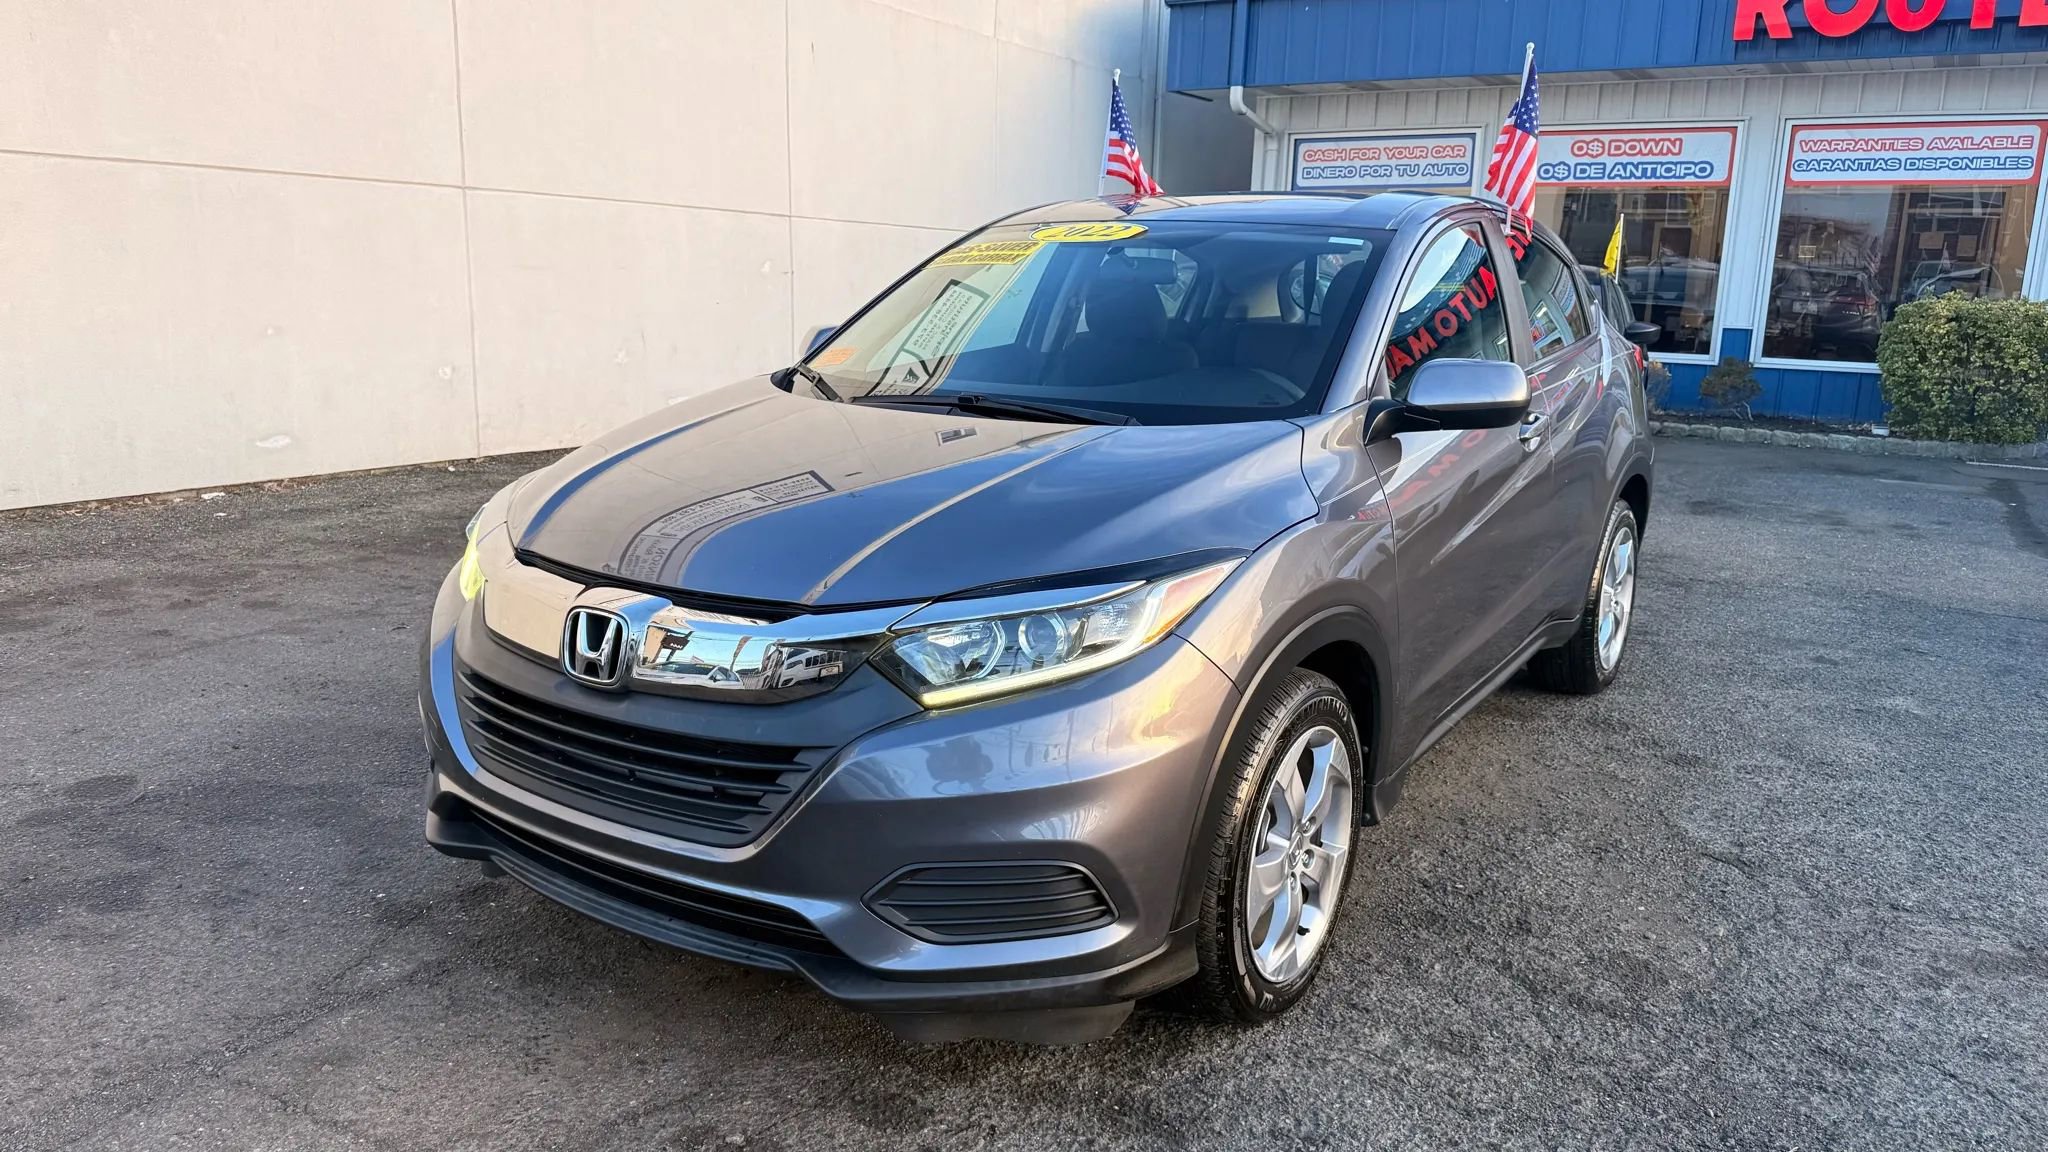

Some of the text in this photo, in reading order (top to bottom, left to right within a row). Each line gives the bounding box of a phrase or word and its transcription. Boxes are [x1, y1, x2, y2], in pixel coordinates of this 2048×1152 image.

[1303, 144, 1467, 162] CASH FOR YOUR CAR
[1608, 137, 1683, 156] DOWN
[1799, 135, 2035, 153] WARRANTIES AVAILABLE
[1302, 162, 1470, 179] DINERO POR TU AUTO
[1573, 162, 1607, 180] DE
[1608, 160, 1714, 180] ANTICIPO
[1793, 155, 2034, 172] GARANTIAS DISPONIBLES
[1043, 225, 1128, 239] 2022
